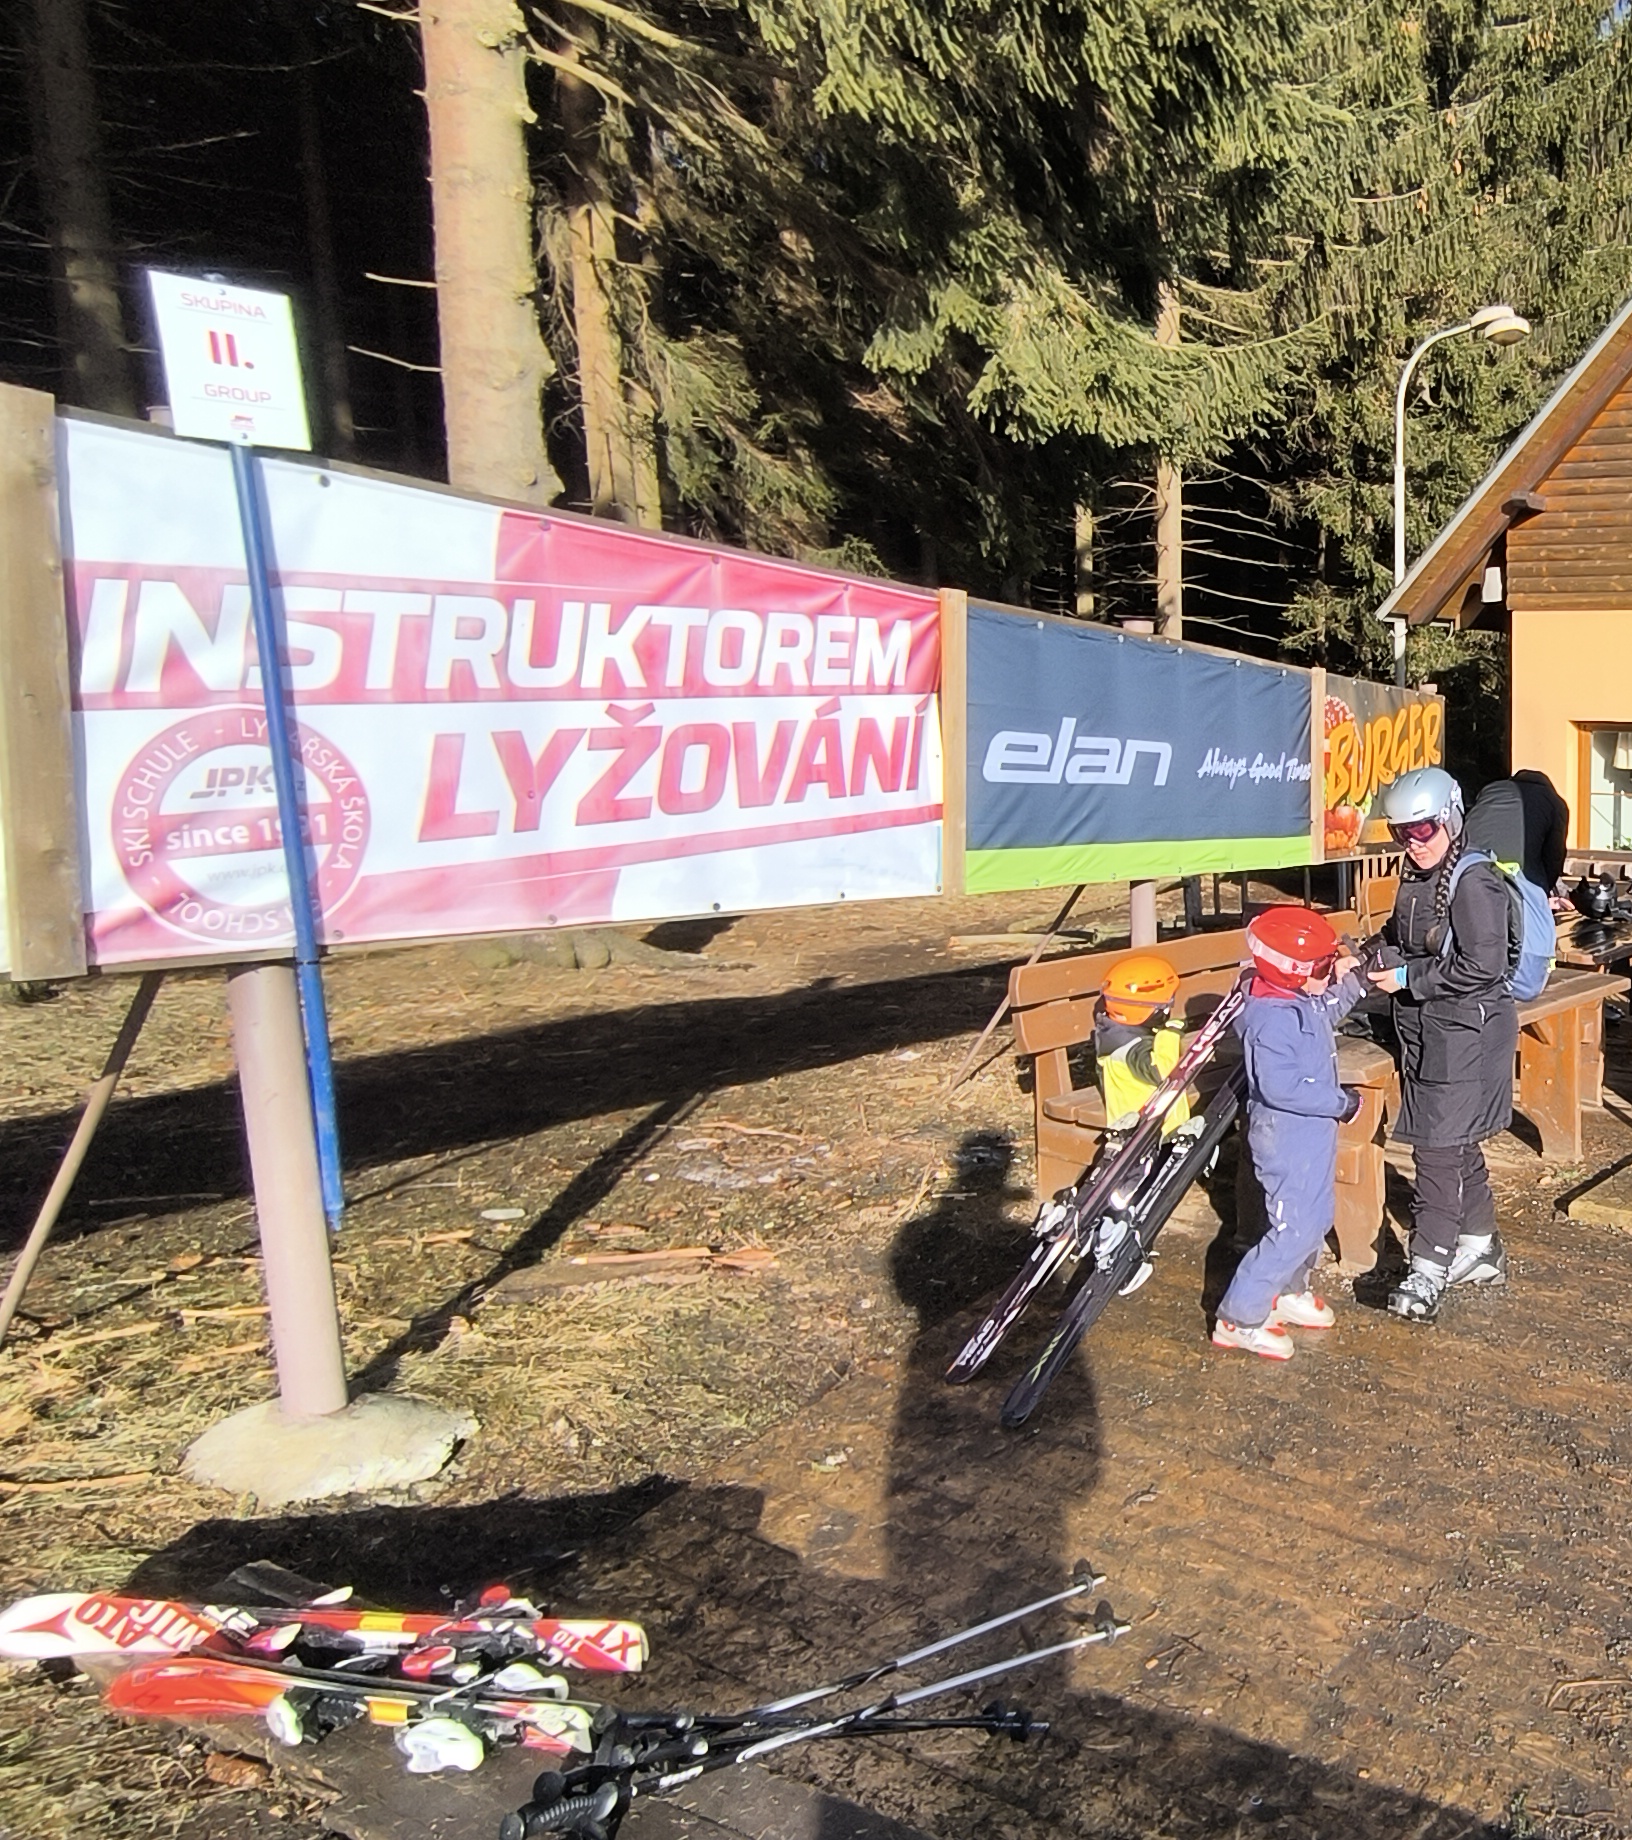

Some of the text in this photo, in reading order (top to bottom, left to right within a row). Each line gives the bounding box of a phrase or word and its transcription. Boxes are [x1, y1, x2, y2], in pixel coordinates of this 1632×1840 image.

[180, 293, 267, 319] SKUPINA
[208, 330, 255, 370] II.
[203, 383, 272, 403] GROUP
[80, 578, 912, 694] INSTRUKTOREM
[418, 695, 931, 843] LYŽOVÁNÍ
[982, 717, 1172, 787] elan
[1197, 747, 1247, 790] Always
[1248, 752, 1286, 785] Good
[1326, 702, 1442, 811] BURGER
[166, 825, 250, 850] since
[331, 796, 367, 871] ŠKOLA
[169, 892, 280, 934] SCHOOL
